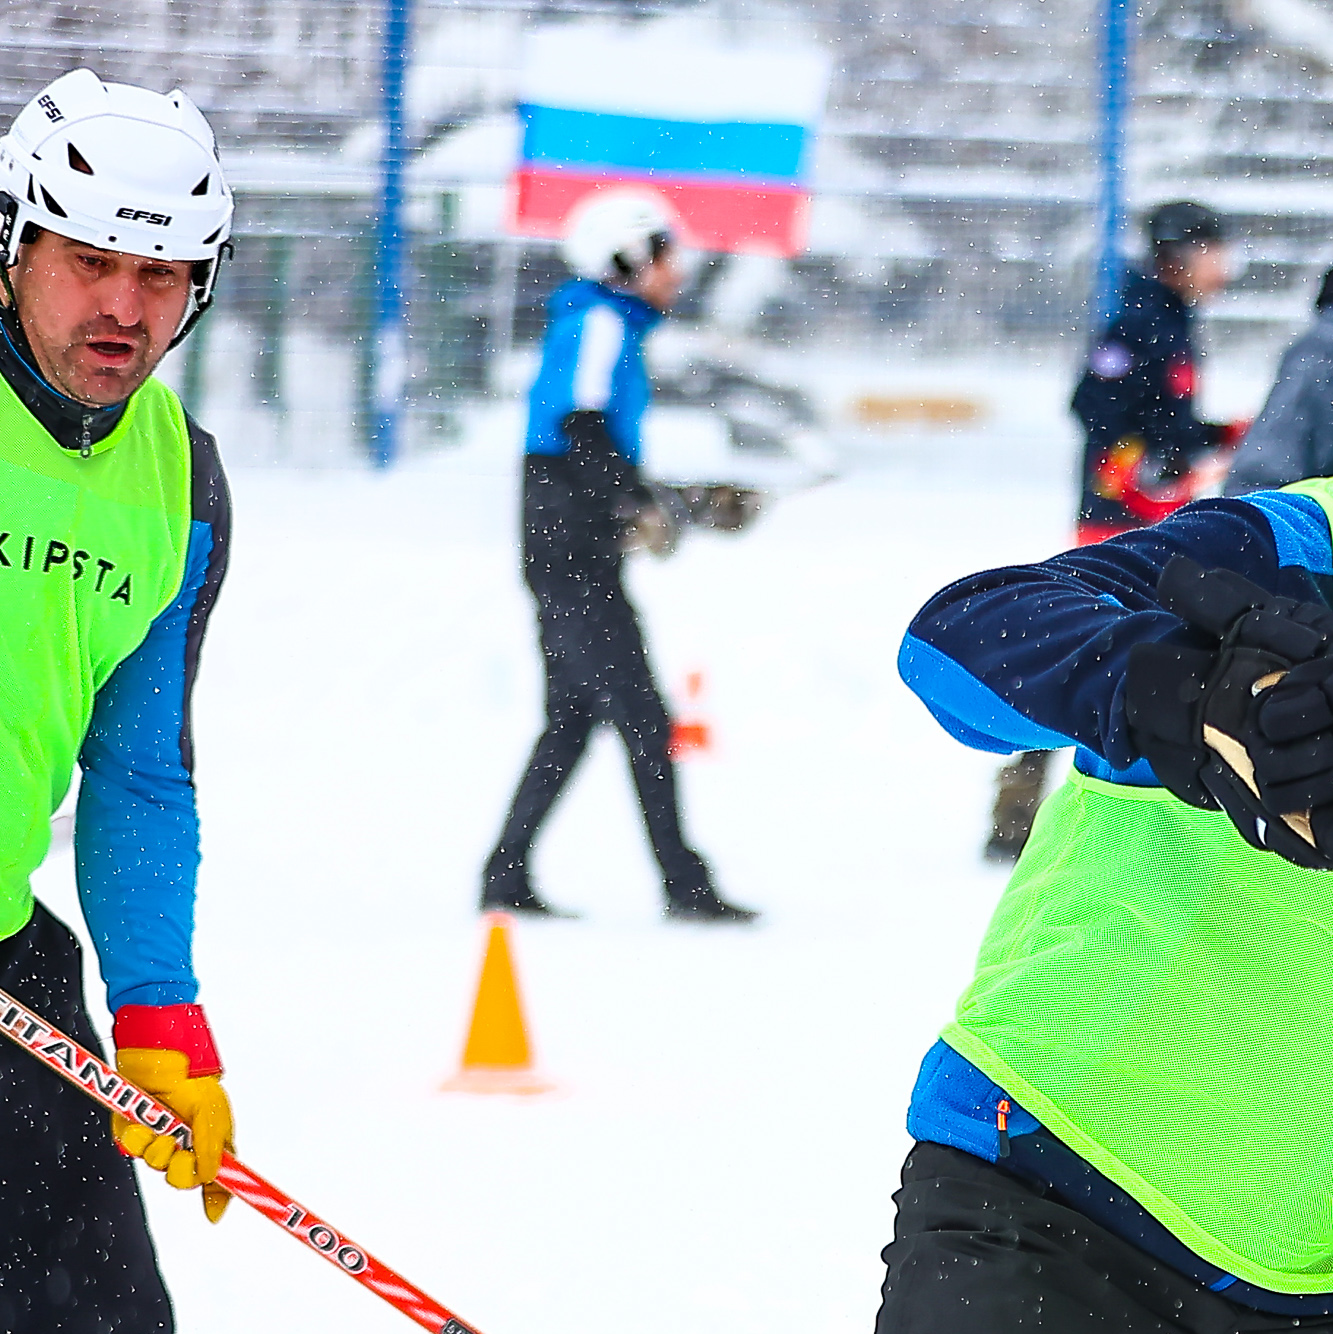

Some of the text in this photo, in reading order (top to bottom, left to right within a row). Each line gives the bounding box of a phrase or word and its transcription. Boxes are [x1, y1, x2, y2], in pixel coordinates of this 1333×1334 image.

[37, 94, 65, 123] EFSI
[115, 207, 173, 227] EFSI
[284, 1204, 369, 1276] 100
